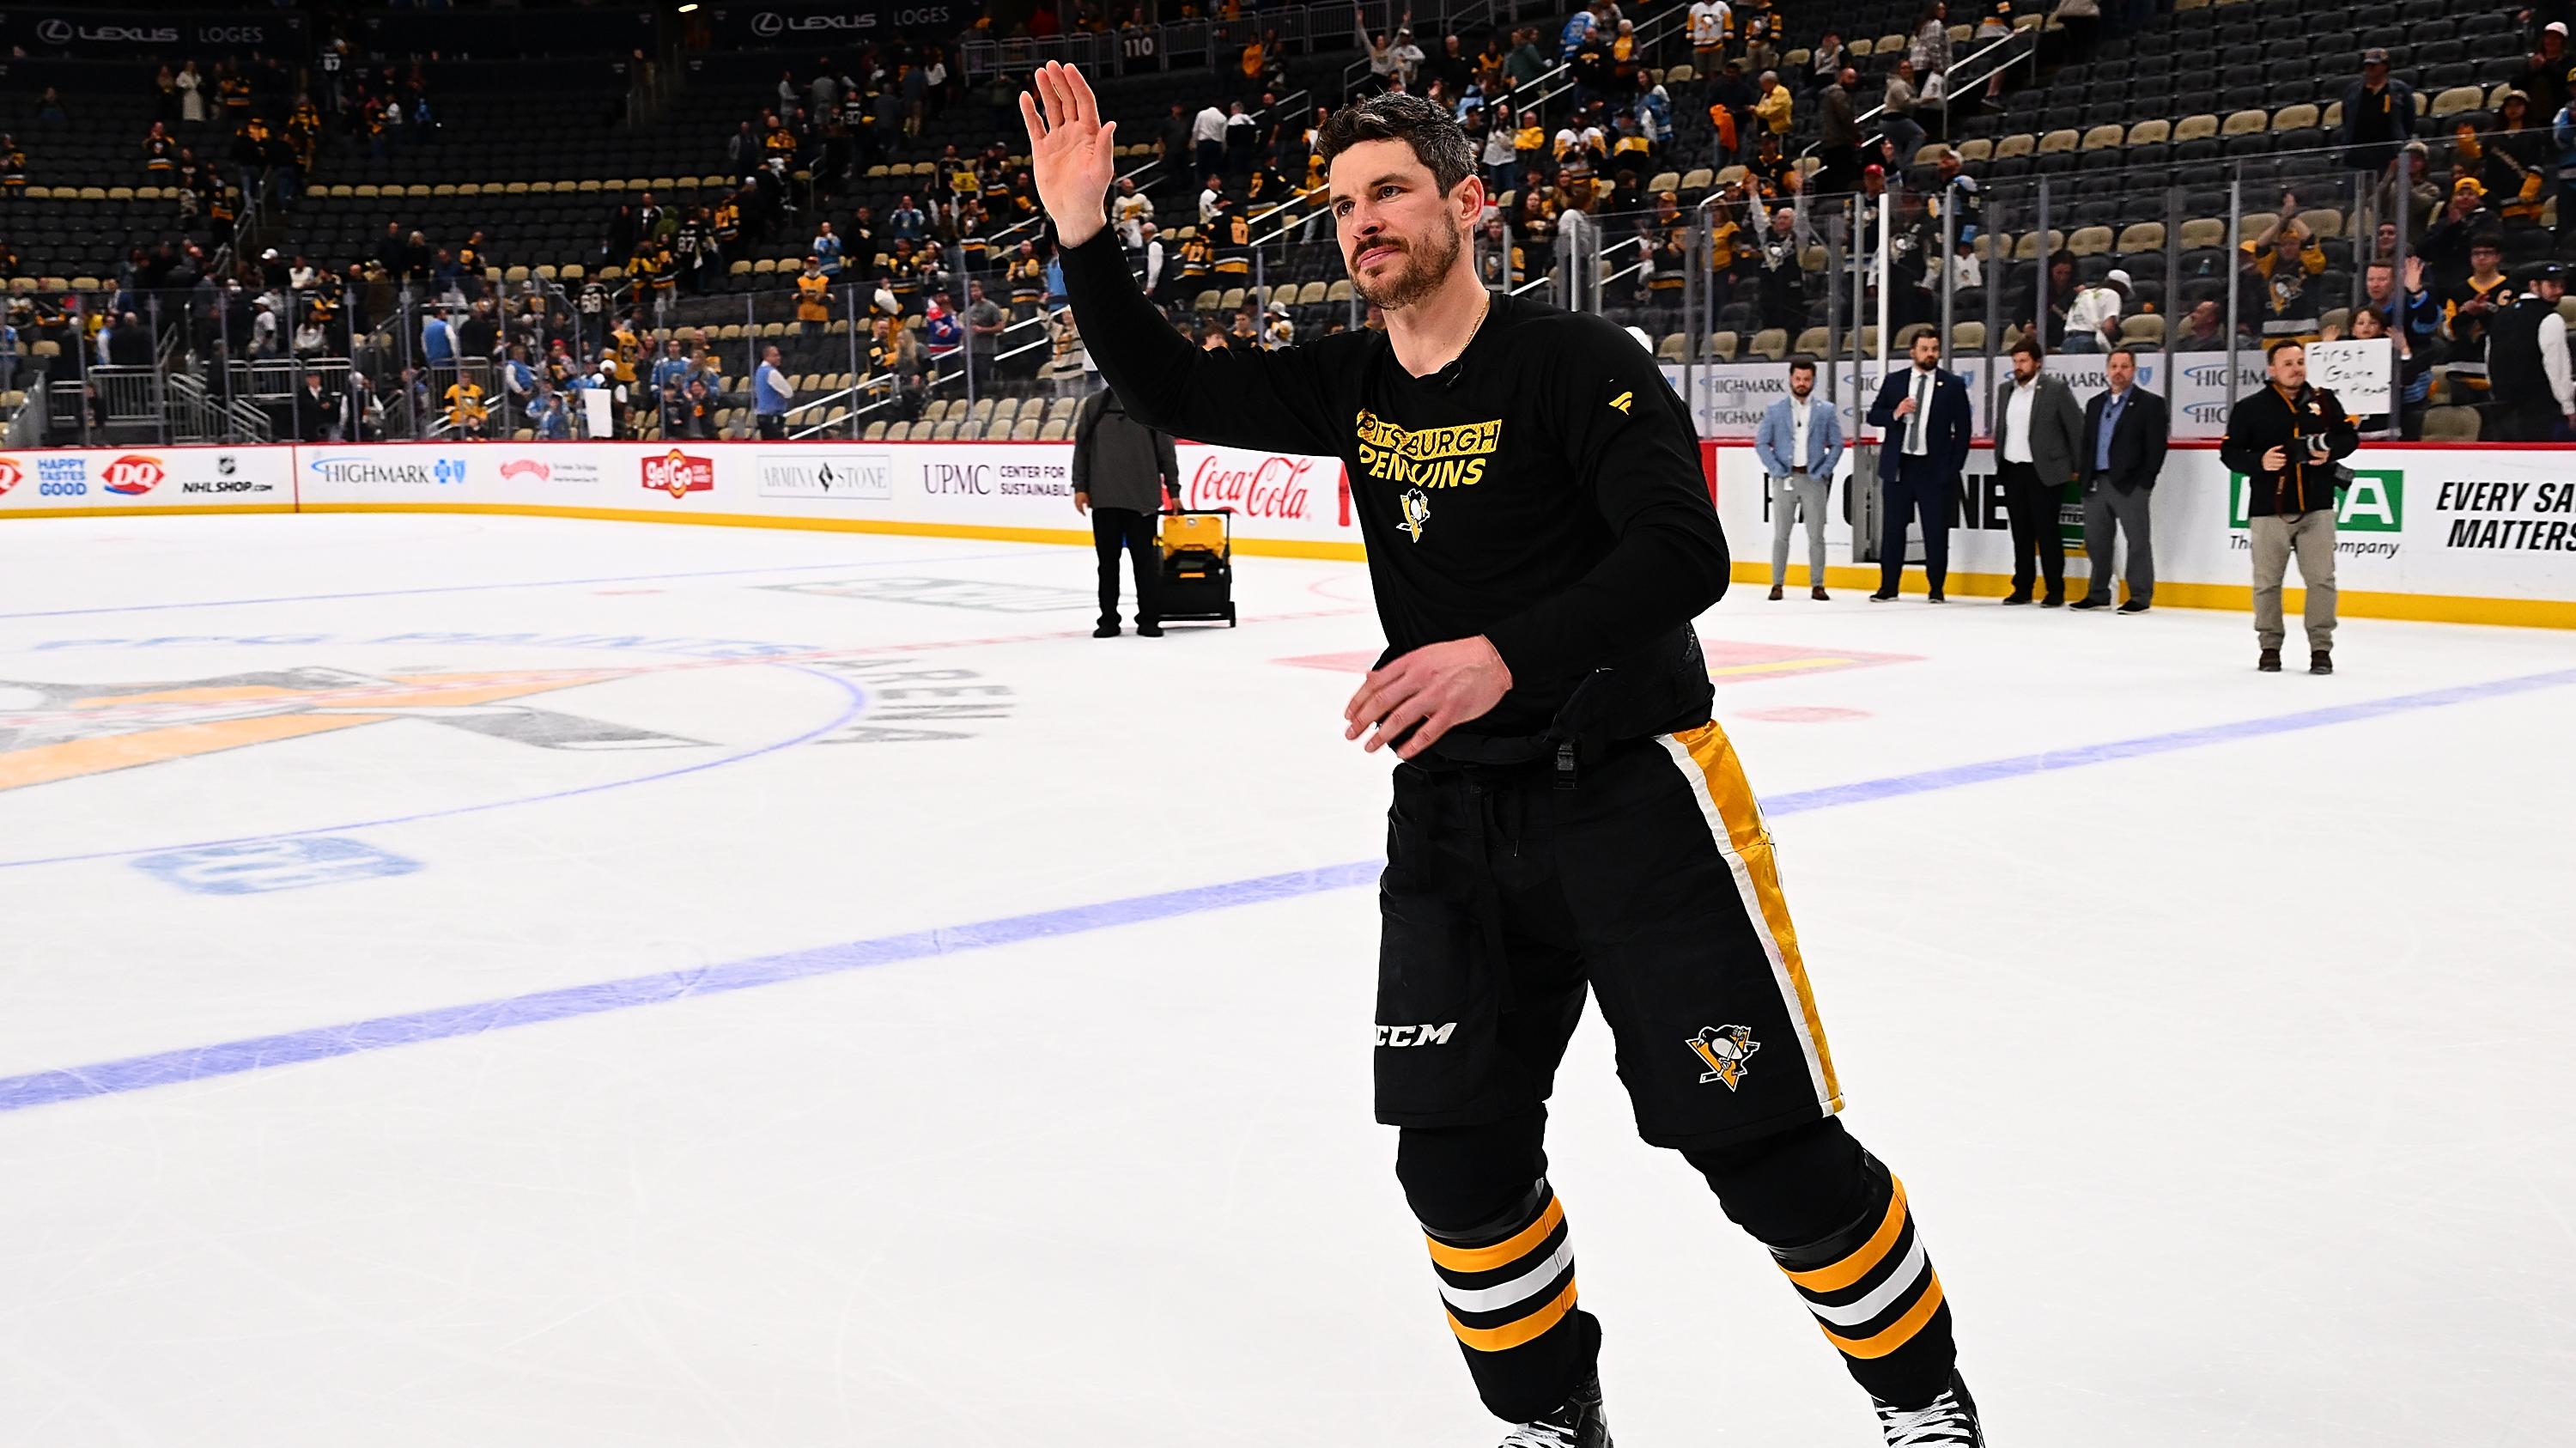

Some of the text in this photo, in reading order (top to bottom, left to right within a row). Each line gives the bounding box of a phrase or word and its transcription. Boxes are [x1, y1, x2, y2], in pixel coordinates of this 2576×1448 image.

[788, 7, 949, 30] LEXUS LOGES
[78, 26, 264, 42] LEXUS LOGES
[1124, 37, 1154, 58] 110
[2497, 289, 2512, 306] C
[2311, 345, 2366, 362] First
[1357, 411, 1499, 459] PITSBURGH
[38, 459, 85, 469] HAPPY
[325, 464, 429, 484] HIGHMARK
[999, 465, 1066, 478] CENTER FOR
[1359, 444, 1486, 489] PENUINS
[39, 471, 86, 481] TASTES
[111, 462, 158, 488] DQ
[763, 466, 887, 489] ARMINA STONE
[923, 465, 991, 495] UPMC
[39, 483, 87, 496] GOOD
[1000, 483, 1072, 496] SUSTAINABIL
[2436, 482, 2576, 514] EVERY SA
[2447, 519, 2576, 551] MATTERS
[2334, 542, 2400, 559] mpany
[1376, 1022, 1458, 1047] CCM
